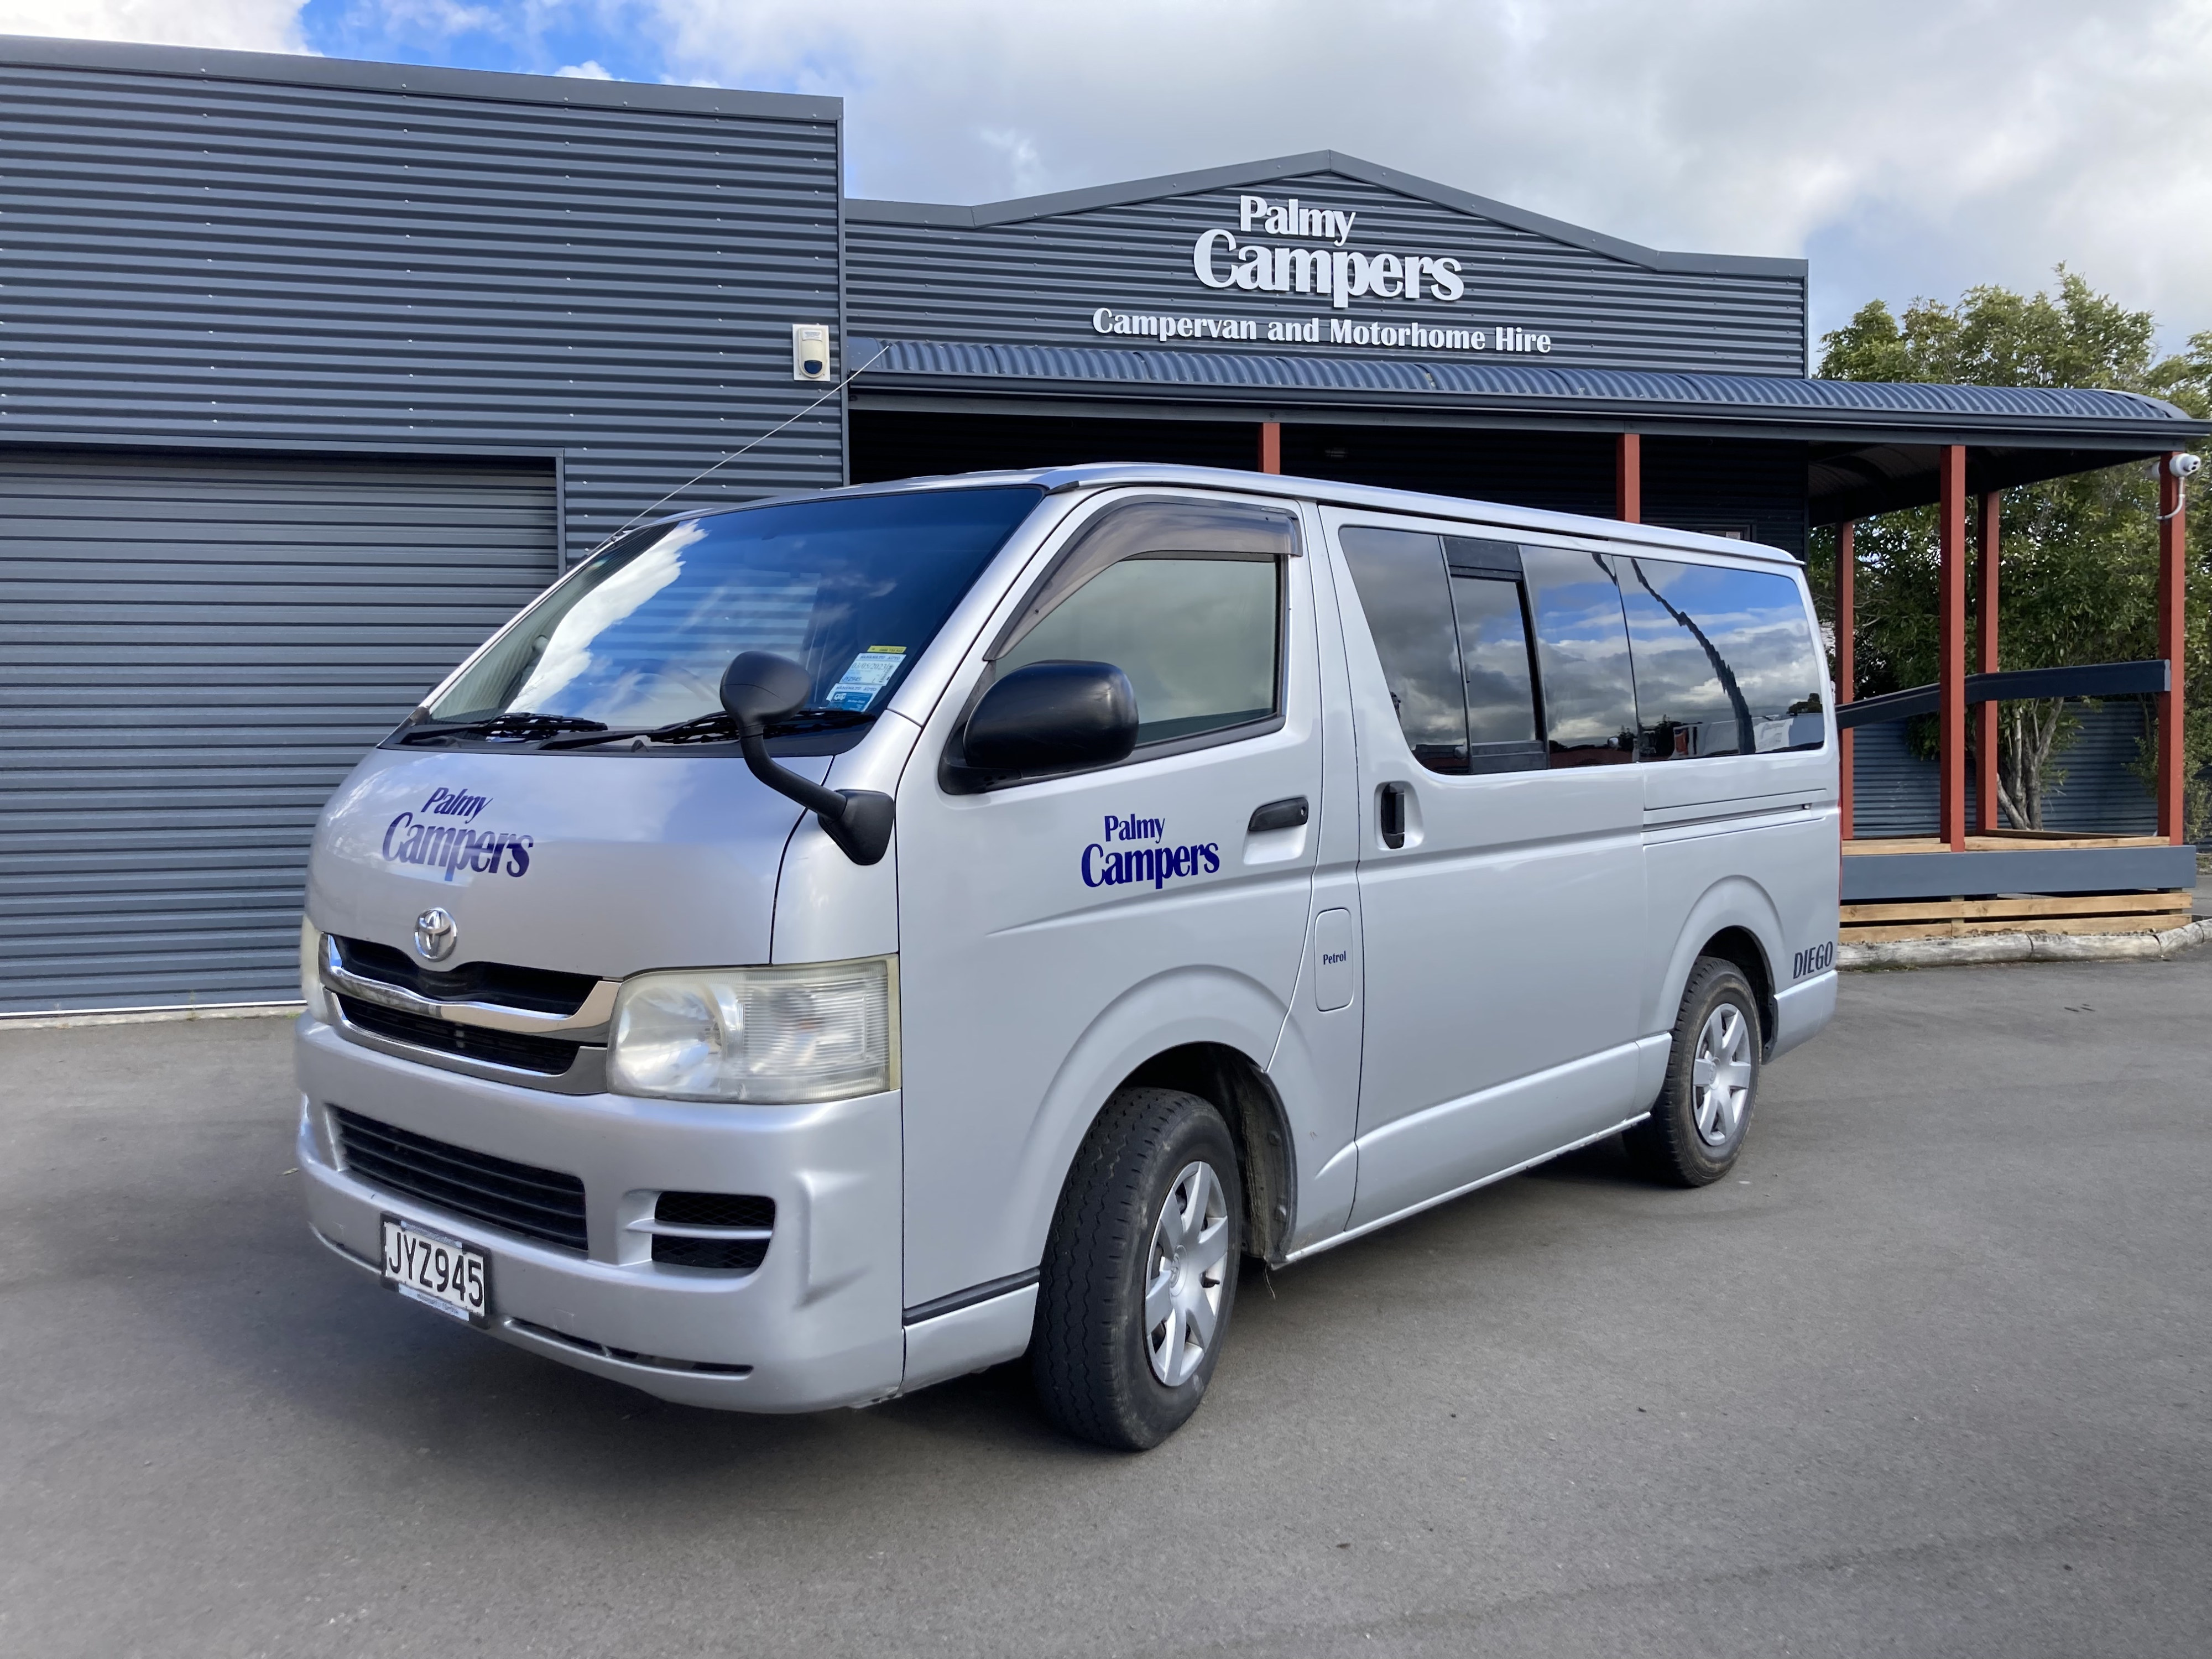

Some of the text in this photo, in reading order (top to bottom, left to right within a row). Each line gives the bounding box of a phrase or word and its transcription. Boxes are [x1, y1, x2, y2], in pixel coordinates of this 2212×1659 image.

[1240, 195, 1356, 247] Palmy
[1193, 228, 1465, 308] Campers
[1092, 307, 1551, 353] Campervan and Motorhome Hire
[421, 787, 493, 824] Palmy
[1104, 813, 1165, 844] Palmy
[382, 812, 534, 881] Campers
[1081, 842, 1220, 889] Campers
[1322, 951, 1347, 966] Petrol
[1793, 941, 1833, 979] DIEGO
[389, 1232, 483, 1307] JYZ945
